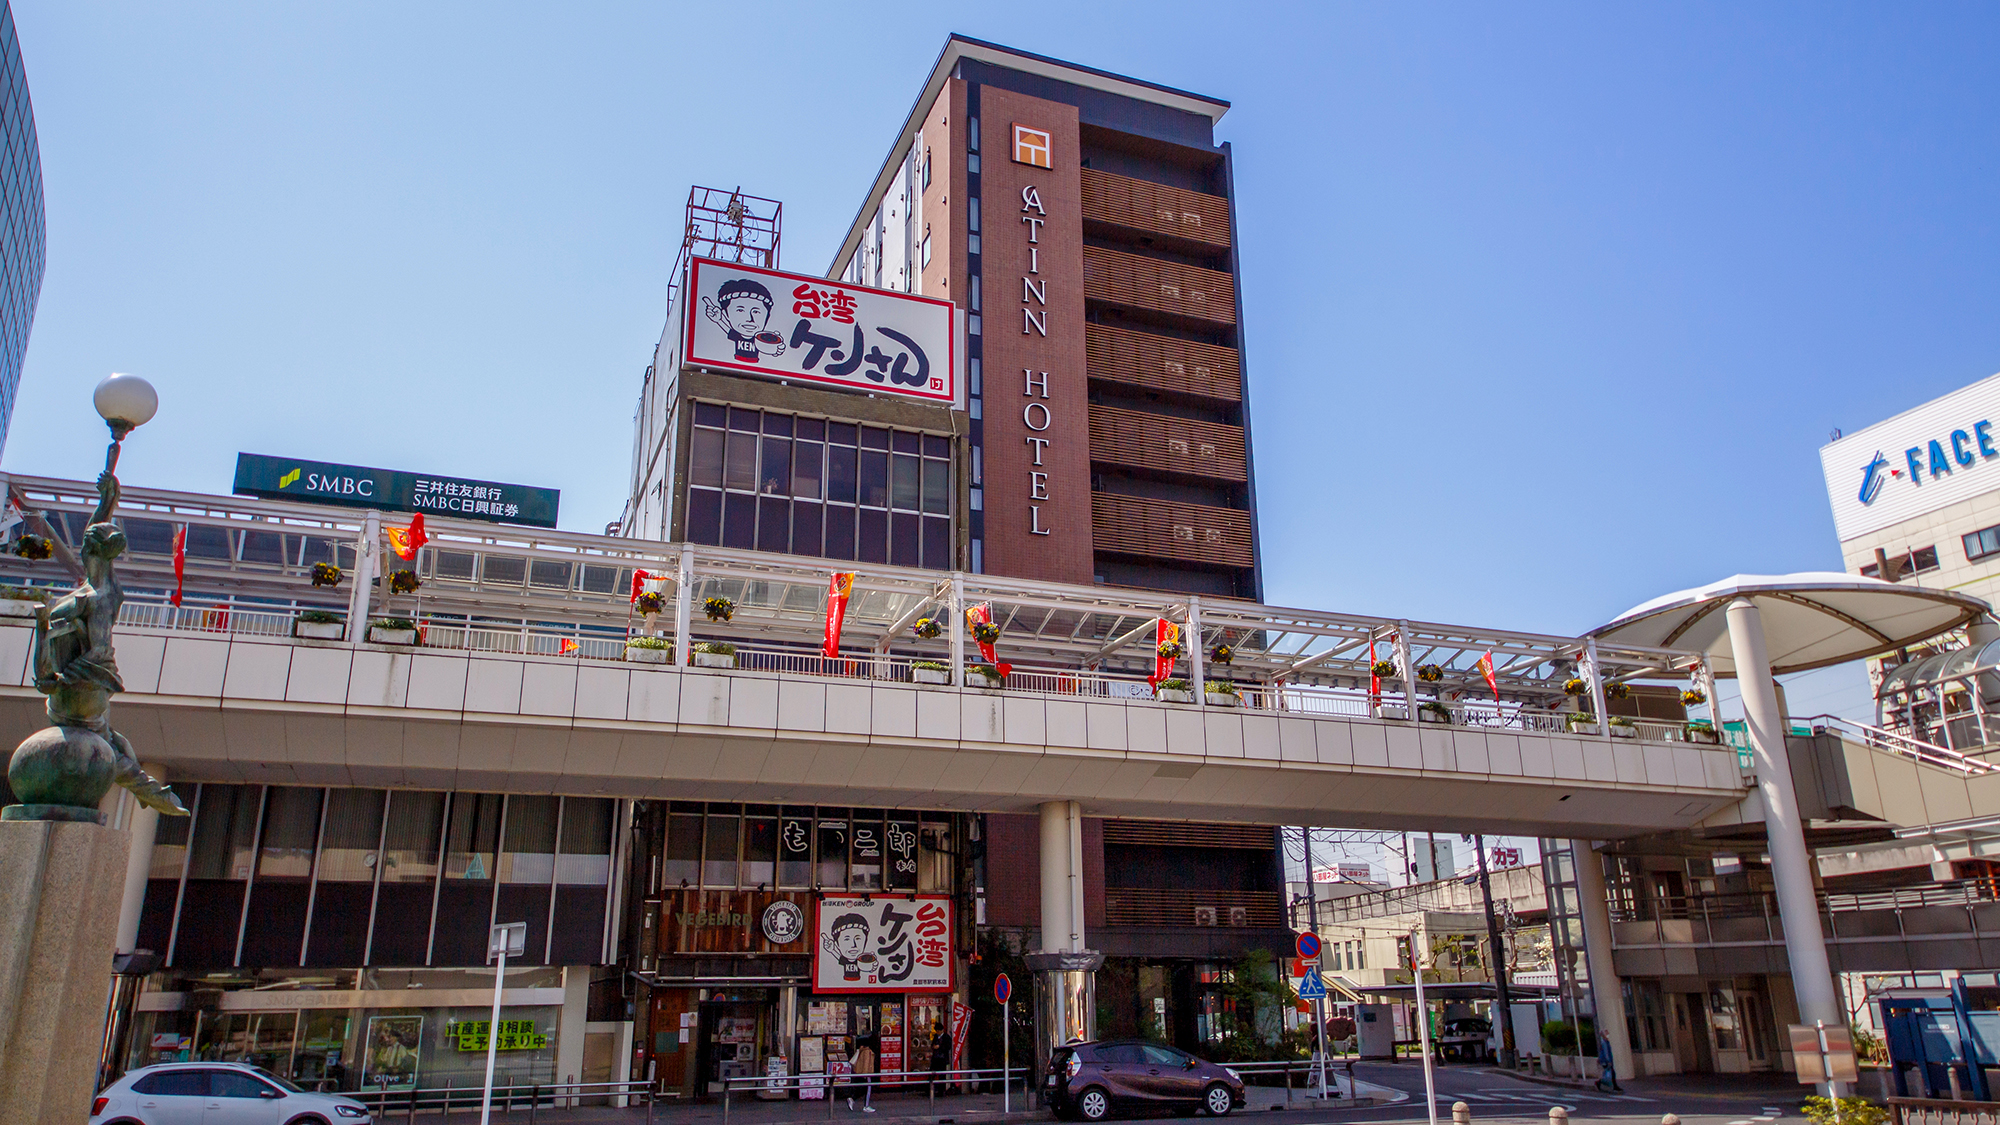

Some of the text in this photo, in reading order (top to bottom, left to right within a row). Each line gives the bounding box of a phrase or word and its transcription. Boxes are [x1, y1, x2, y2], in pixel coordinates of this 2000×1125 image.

[792, 283, 858, 324] 台湾
[737, 340, 756, 353] KEN
[789, 318, 930, 387] ケンさん
[1022, 368, 1051, 536] HOTEL
[306, 473, 374, 497] SMBC
[414, 480, 502, 501] 三井住友銀行
[412, 494, 519, 518] SMBC日興証券
[1494, 847, 1519, 866] カラ
[675, 912, 753, 926] VEGEBIRD
[877, 903, 915, 984] ケンさん
[915, 902, 948, 968] 台湾
[845, 964, 859, 972] KEN
